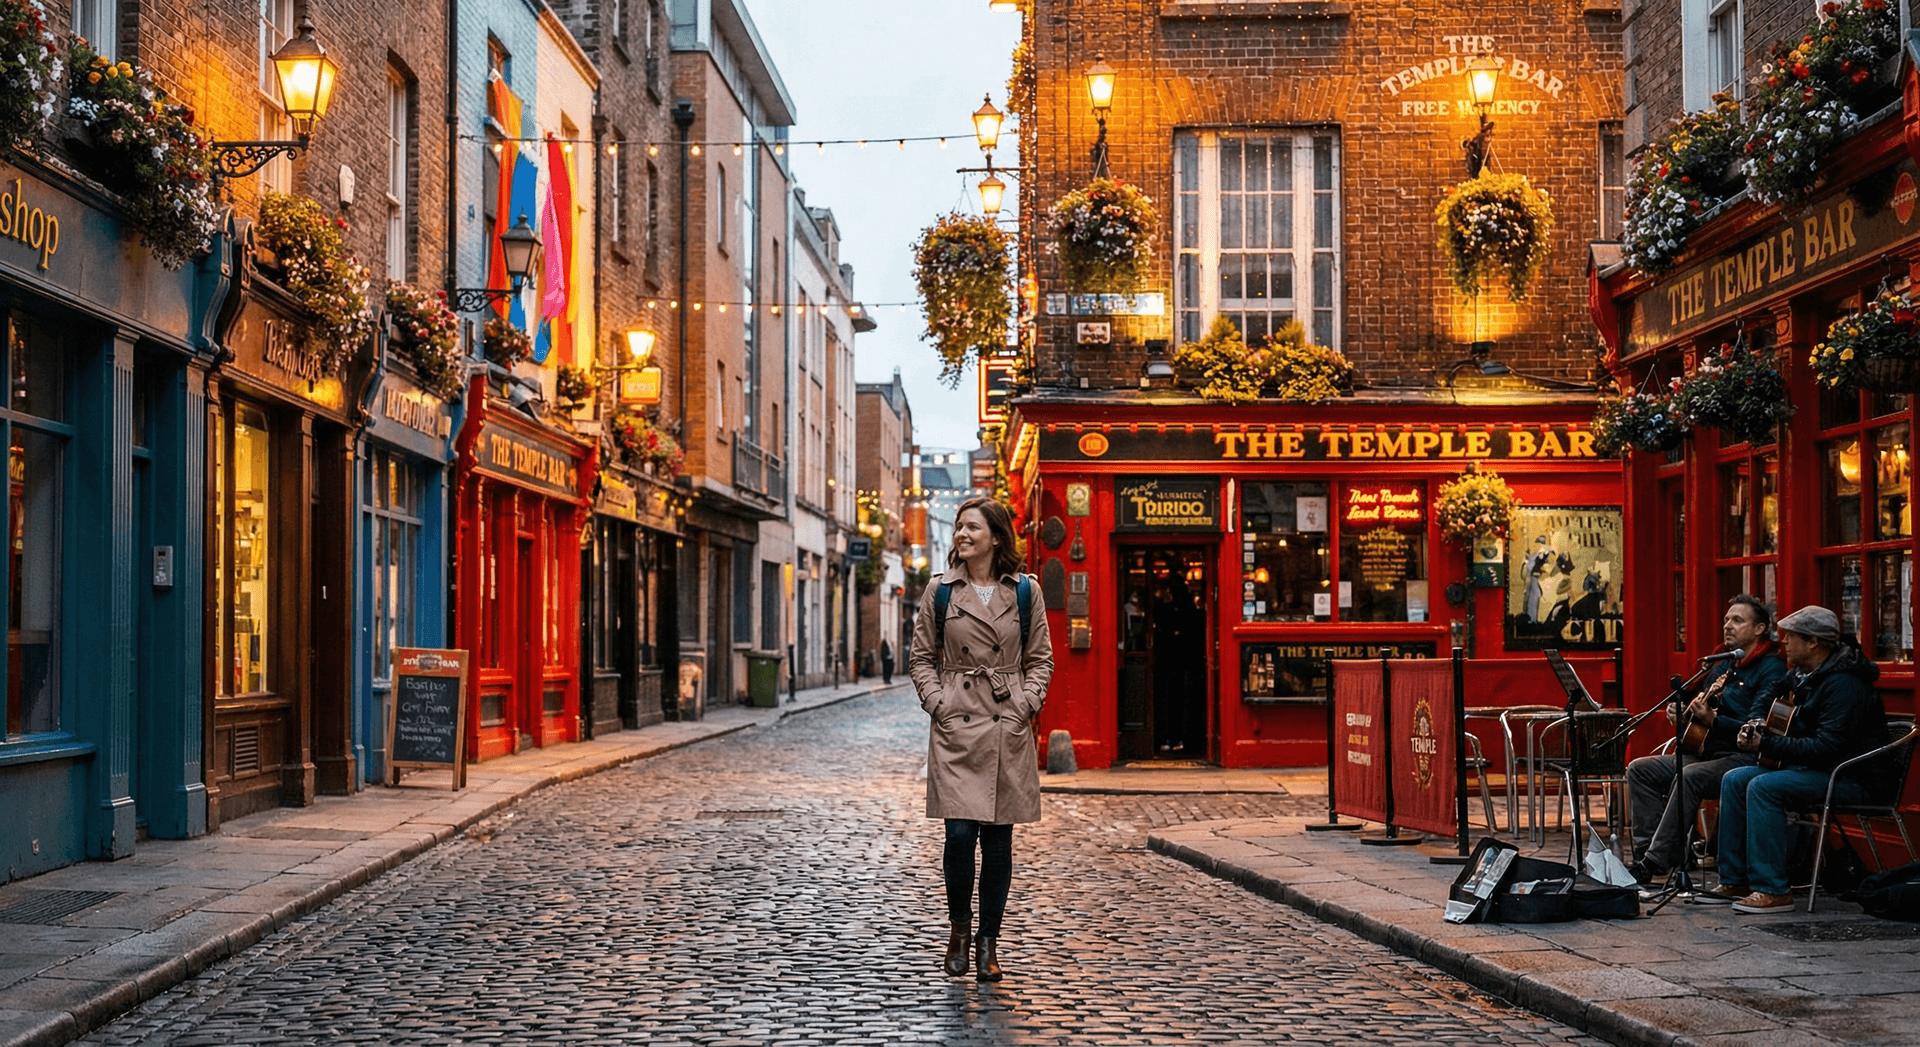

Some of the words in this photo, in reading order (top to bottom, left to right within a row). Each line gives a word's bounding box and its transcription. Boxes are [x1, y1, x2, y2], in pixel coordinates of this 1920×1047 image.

[1442, 35, 1495, 54] THE
[1509, 58, 1564, 99] BAR
[1402, 100, 1450, 116] FREE
[0, 178, 60, 270] shop
[1667, 271, 1706, 326] THE
[1710, 227, 1797, 308] TEMPLE
[1804, 201, 1857, 268] BAR
[1214, 432, 1306, 458] THE
[1319, 431, 1492, 458] TEMPLE
[1508, 431, 1598, 458] BAR
[491, 433, 511, 468] THE
[513, 441, 548, 481] TEMPLE
[548, 456, 566, 488] BAR
[1277, 646, 1306, 658] THE
[1411, 737, 1437, 755] TEMPLE
